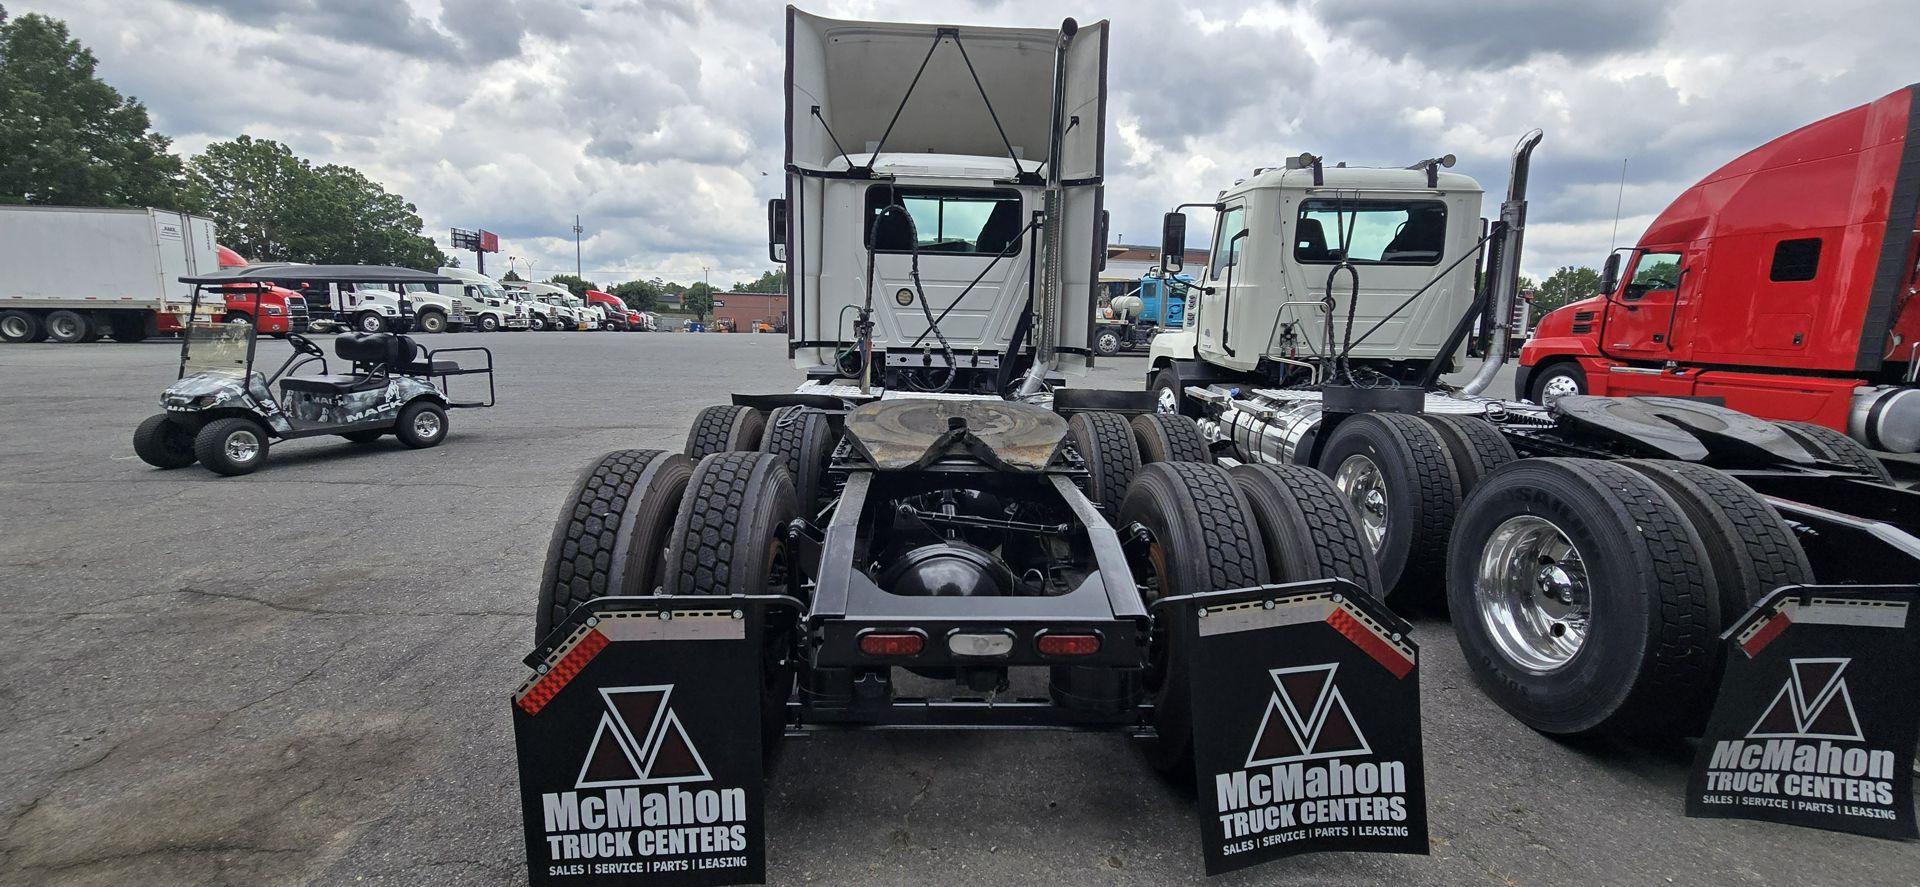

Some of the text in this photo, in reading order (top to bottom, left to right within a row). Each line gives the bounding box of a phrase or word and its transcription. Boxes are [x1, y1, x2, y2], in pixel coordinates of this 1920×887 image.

[346, 400, 405, 423] MACK
[1709, 740, 1895, 780] McMahon
[1215, 758, 1406, 813] McMahon
[1706, 771, 1894, 805] TRUCK CENTERS
[542, 785, 747, 833] McMahon
[1219, 796, 1407, 840] TRUCK CENTERS
[1703, 794, 1733, 805] SALES
[1742, 796, 1789, 809] SERVICE
[1798, 801, 1835, 814] PARTS
[1844, 805, 1896, 821] LEASING
[547, 825, 747, 860] TRUCK CENTERS
[1223, 839, 1255, 856] SALES
[1262, 829, 1306, 847] SERVICE
[1314, 826, 1349, 838] PARTS
[1358, 826, 1409, 837] LEASING
[549, 863, 585, 876] SALES
[594, 862, 644, 874] SERVICE
[653, 859, 689, 872] PARTS
[698, 855, 747, 869] LEASING
